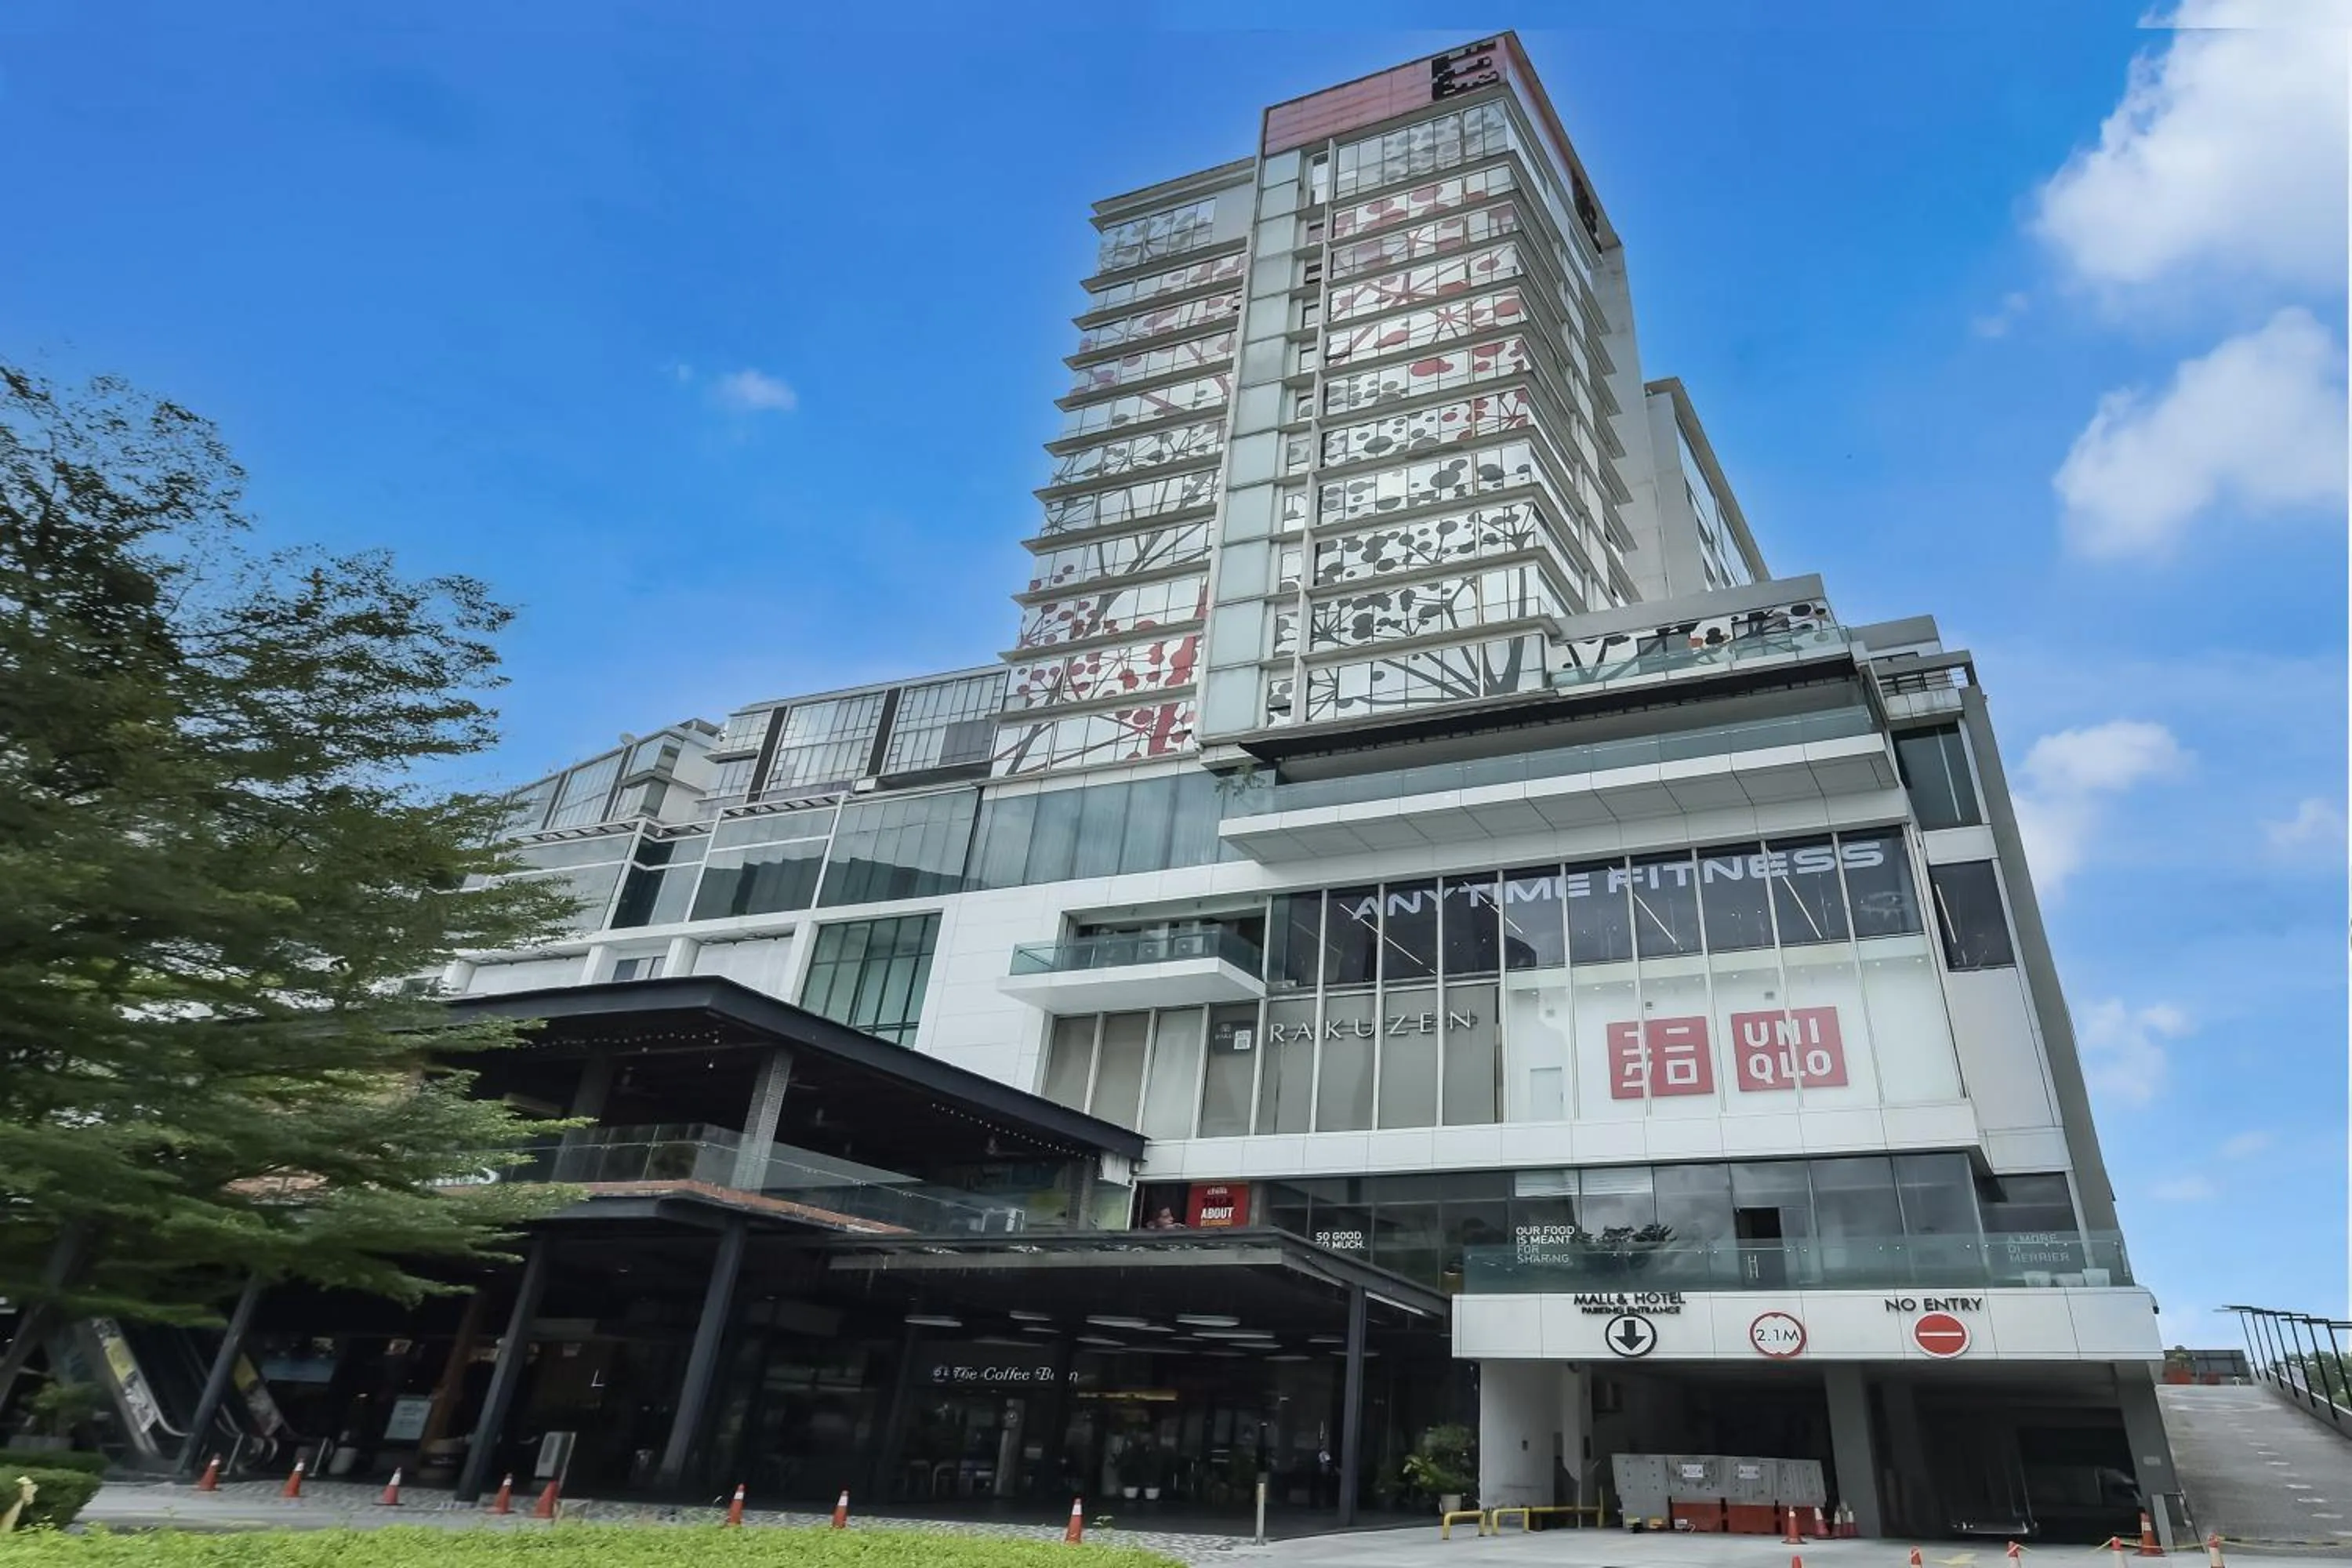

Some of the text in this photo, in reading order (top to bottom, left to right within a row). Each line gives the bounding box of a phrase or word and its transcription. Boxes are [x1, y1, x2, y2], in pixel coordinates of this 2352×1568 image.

[1352, 841, 1884, 920] ANYTIME FITNESS
[1269, 1008, 1474, 1044] RAKUZEN
[1744, 1017, 1820, 1048] UNI
[1749, 1049, 1832, 1084] QLO
[1200, 1207, 1235, 1219] ABOUT
[1316, 1232, 1330, 1241] SO
[1515, 1225, 1575, 1236] OUR FOOD
[1516, 1235, 1571, 1245] IS MEANT
[1517, 1245, 1540, 1254] FOR
[1517, 1254, 1570, 1265] SHARING
[1573, 1292, 1686, 1305] MALL & HOTEL
[1885, 1297, 1983, 1312] NO ENTRY
[1581, 1305, 1682, 1315] PARKING ENTRANCE
[1755, 1329, 1799, 1342] 2.1M
[953, 1366, 1079, 1383] The Coffee Bn
